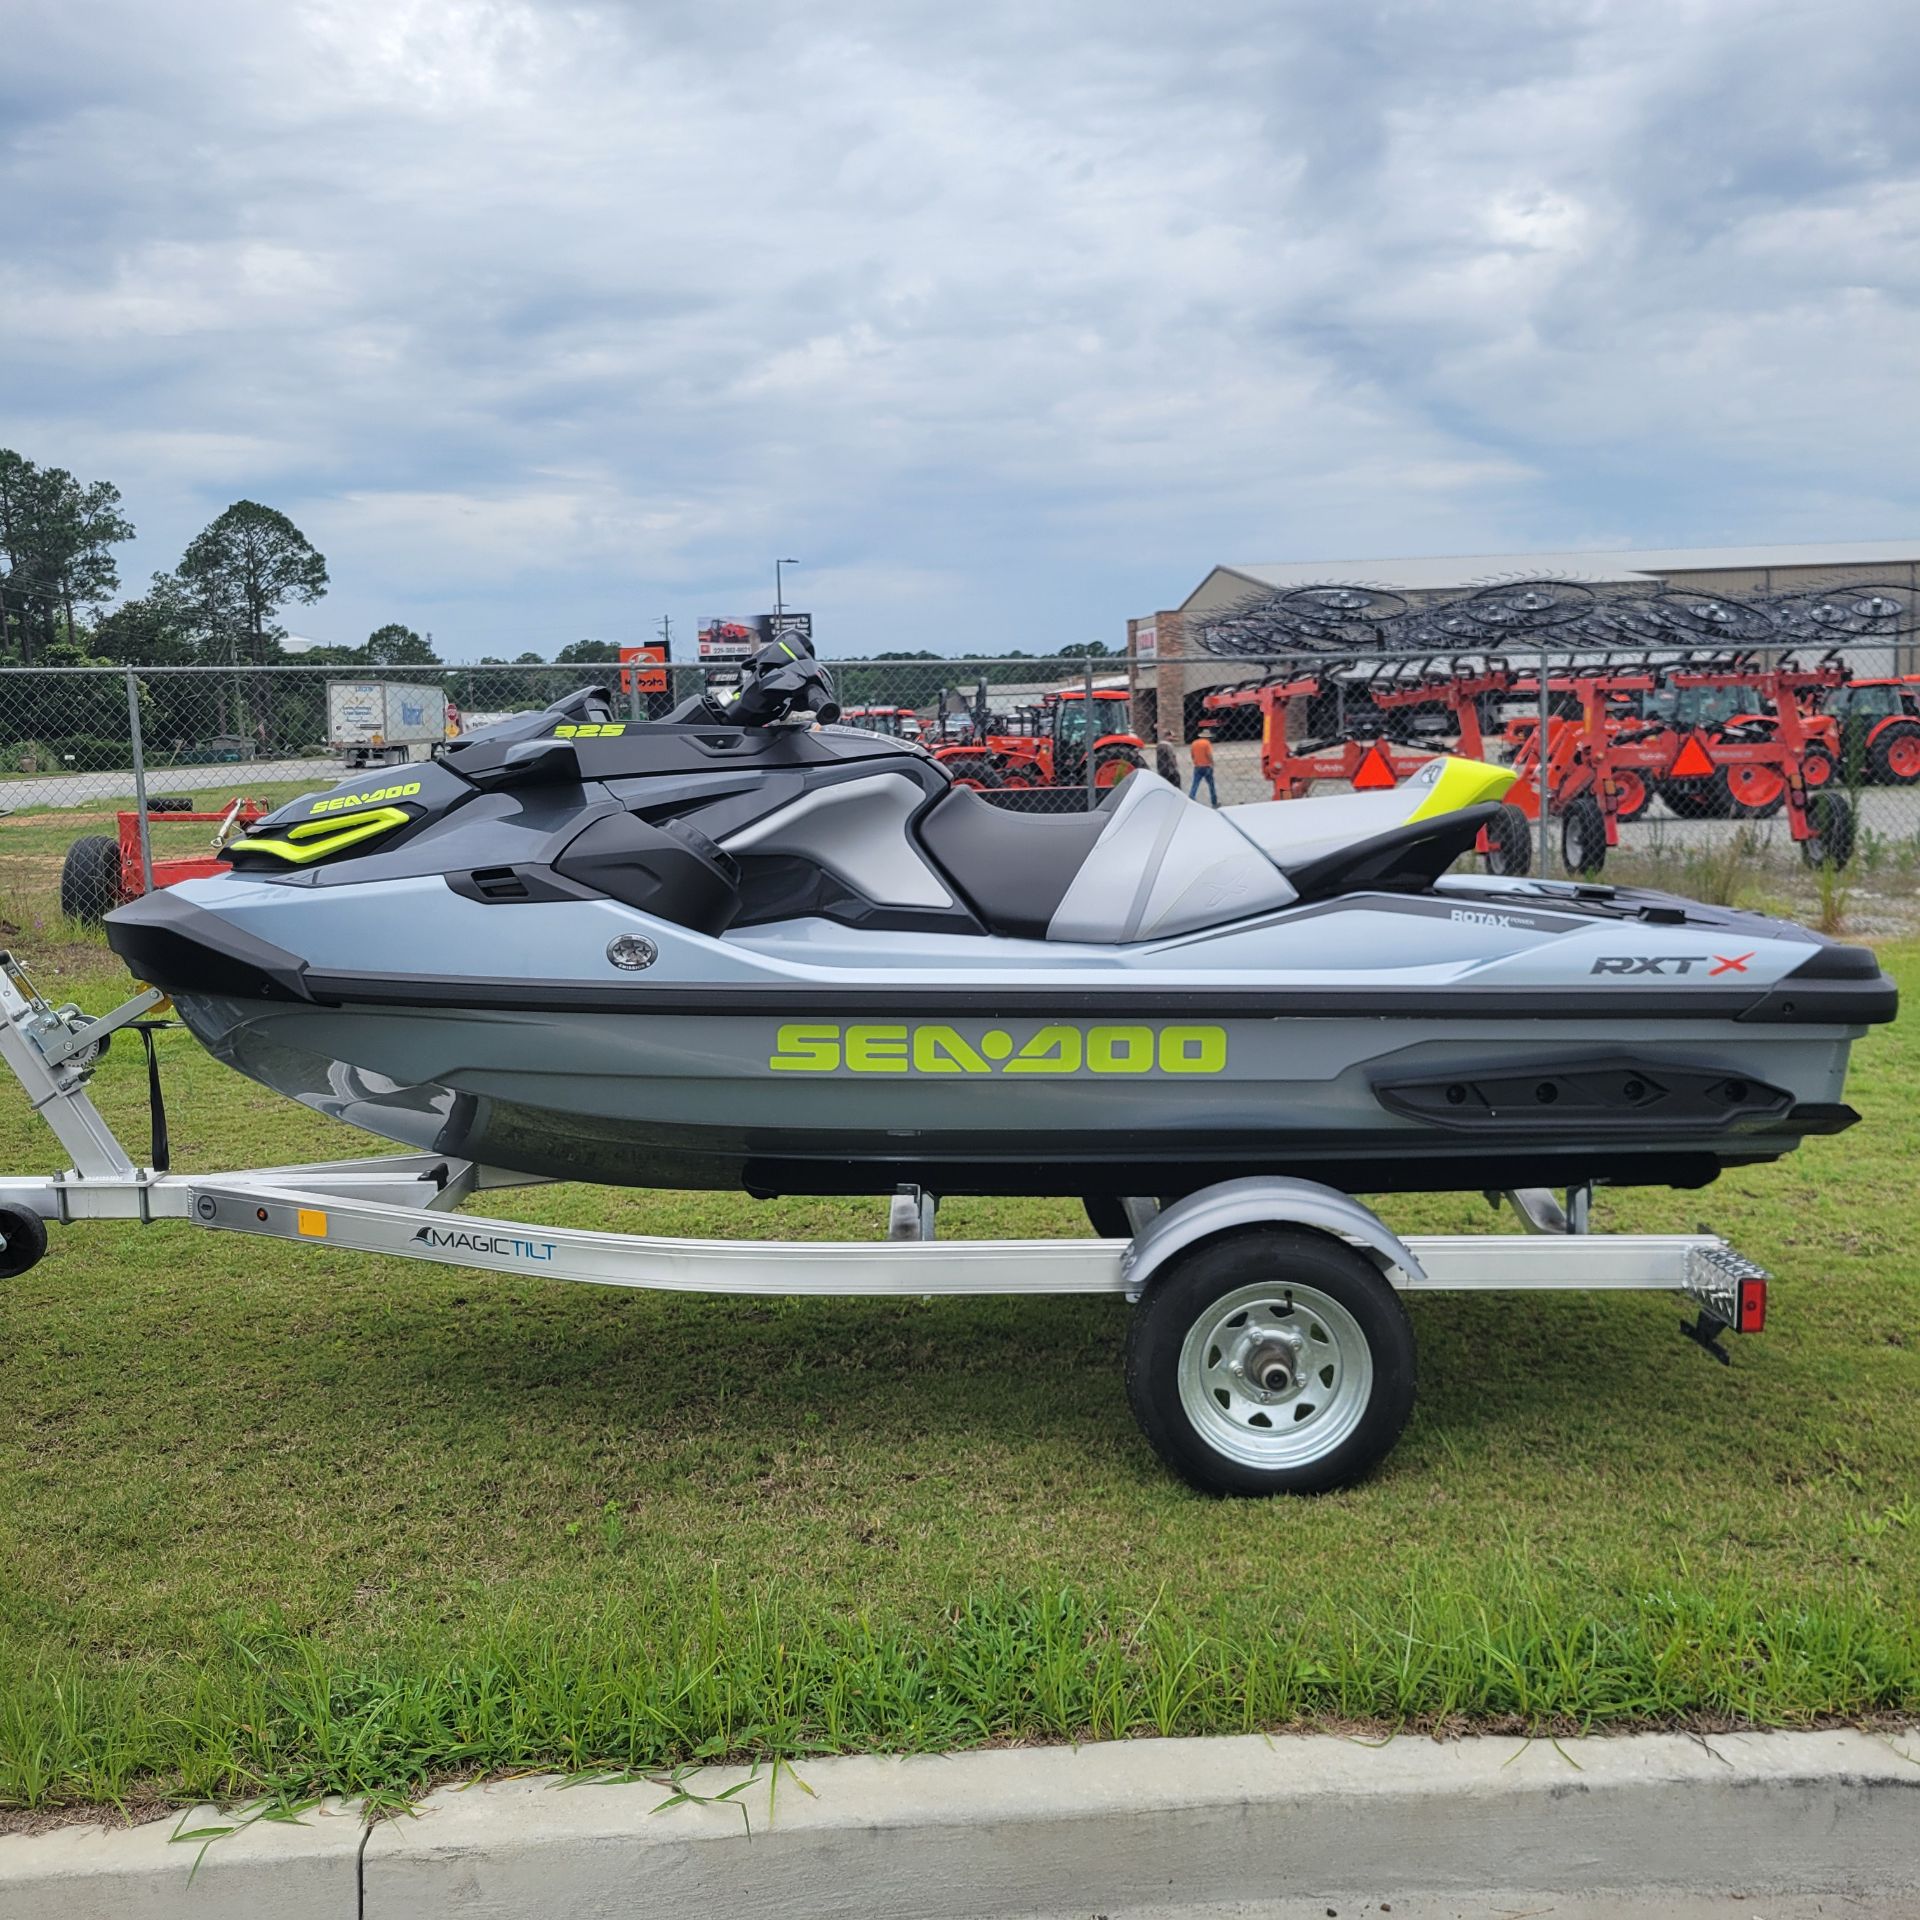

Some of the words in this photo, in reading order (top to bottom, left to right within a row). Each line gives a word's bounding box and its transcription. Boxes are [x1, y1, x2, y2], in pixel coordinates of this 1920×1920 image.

[624, 677, 664, 687] Kbota
[553, 724, 626, 739] 325
[1450, 909, 1510, 928] ROTAX
[1589, 956, 1709, 976] RXT
[1707, 951, 1757, 977] X
[432, 1229, 557, 1261] MAGICTILT
